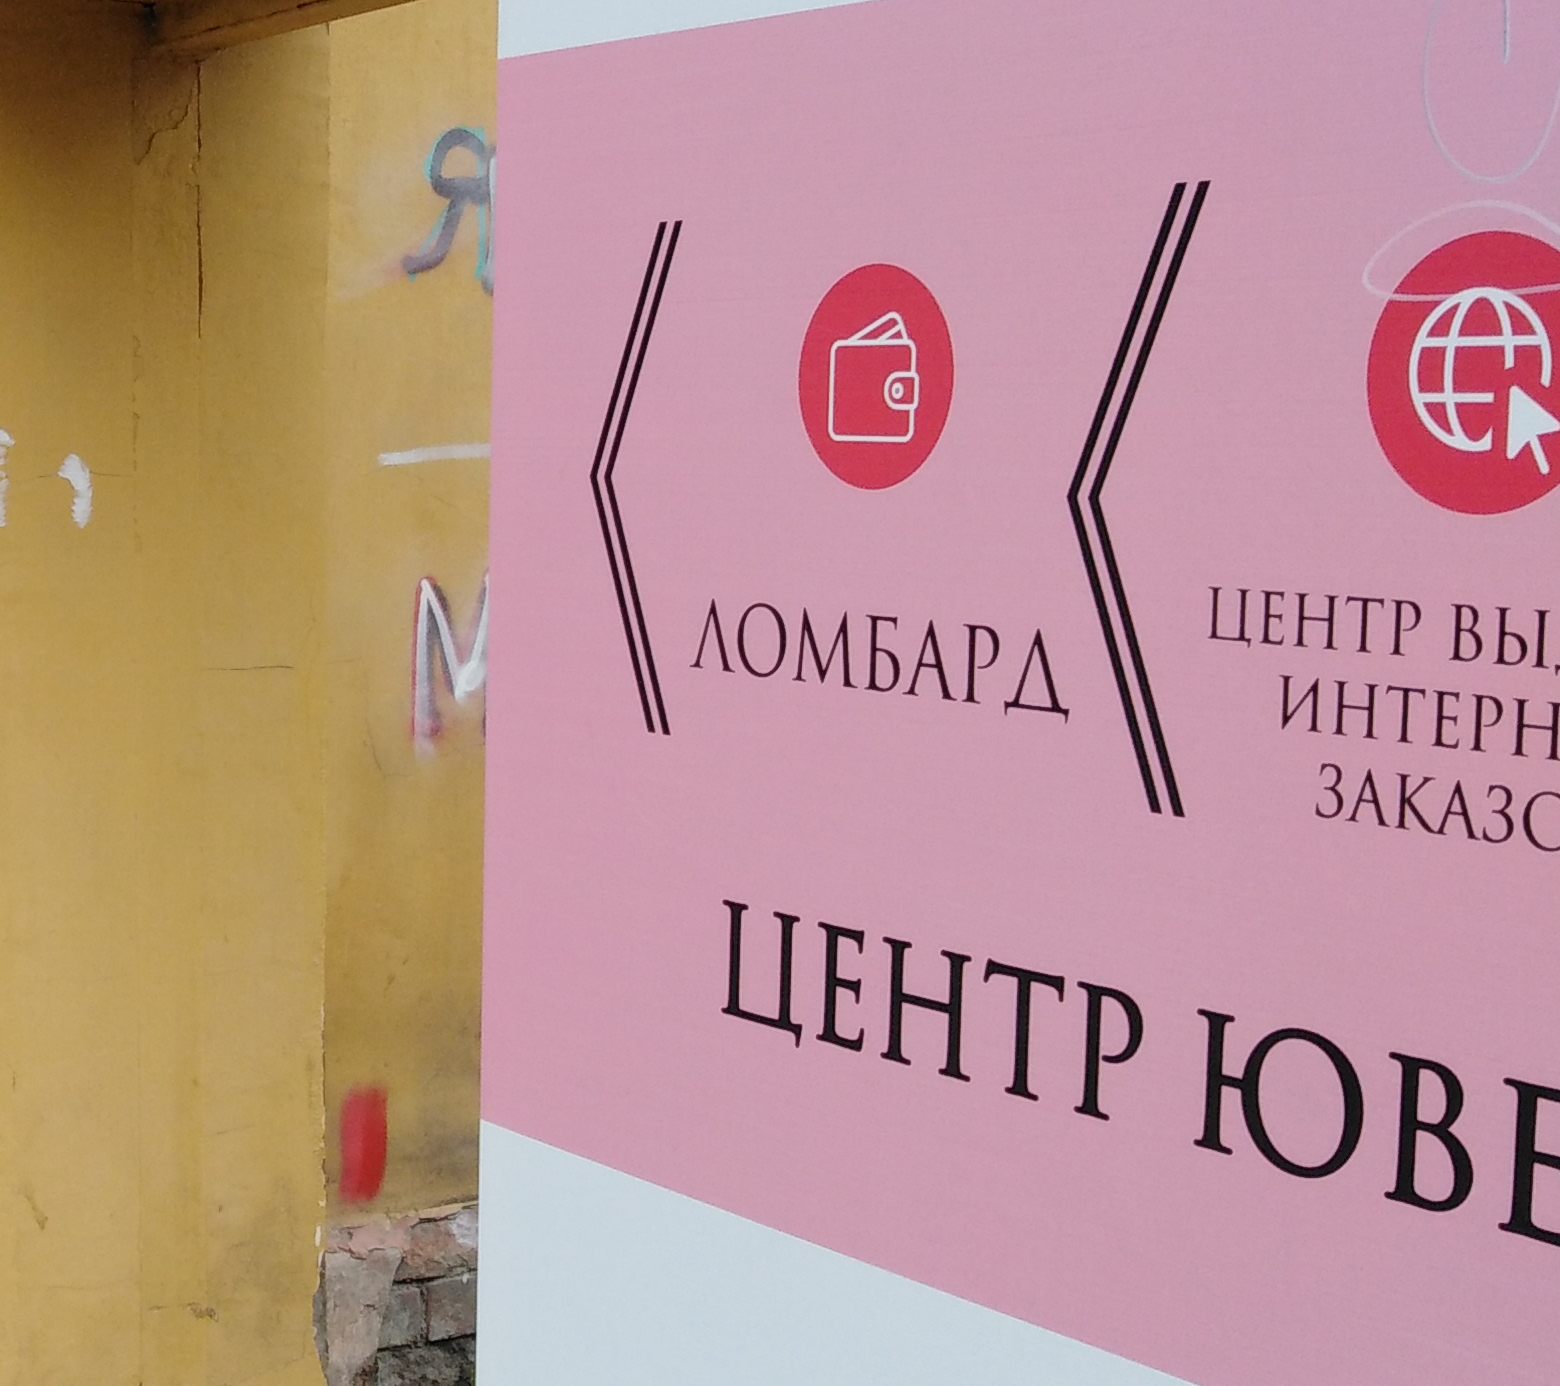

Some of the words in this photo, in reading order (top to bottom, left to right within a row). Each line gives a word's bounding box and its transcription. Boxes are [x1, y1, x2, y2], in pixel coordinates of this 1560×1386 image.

[690, 598, 1070, 724] ЛОМБАРД
[1206, 586, 1422, 657] ЦЕНТР
[1448, 603, 1560, 676] ВЫ
[1278, 674, 1560, 761] ИНТЕРН
[720, 899, 1144, 1122] ЦЕНТР
[1193, 1008, 1560, 1248] ЮВЕ
